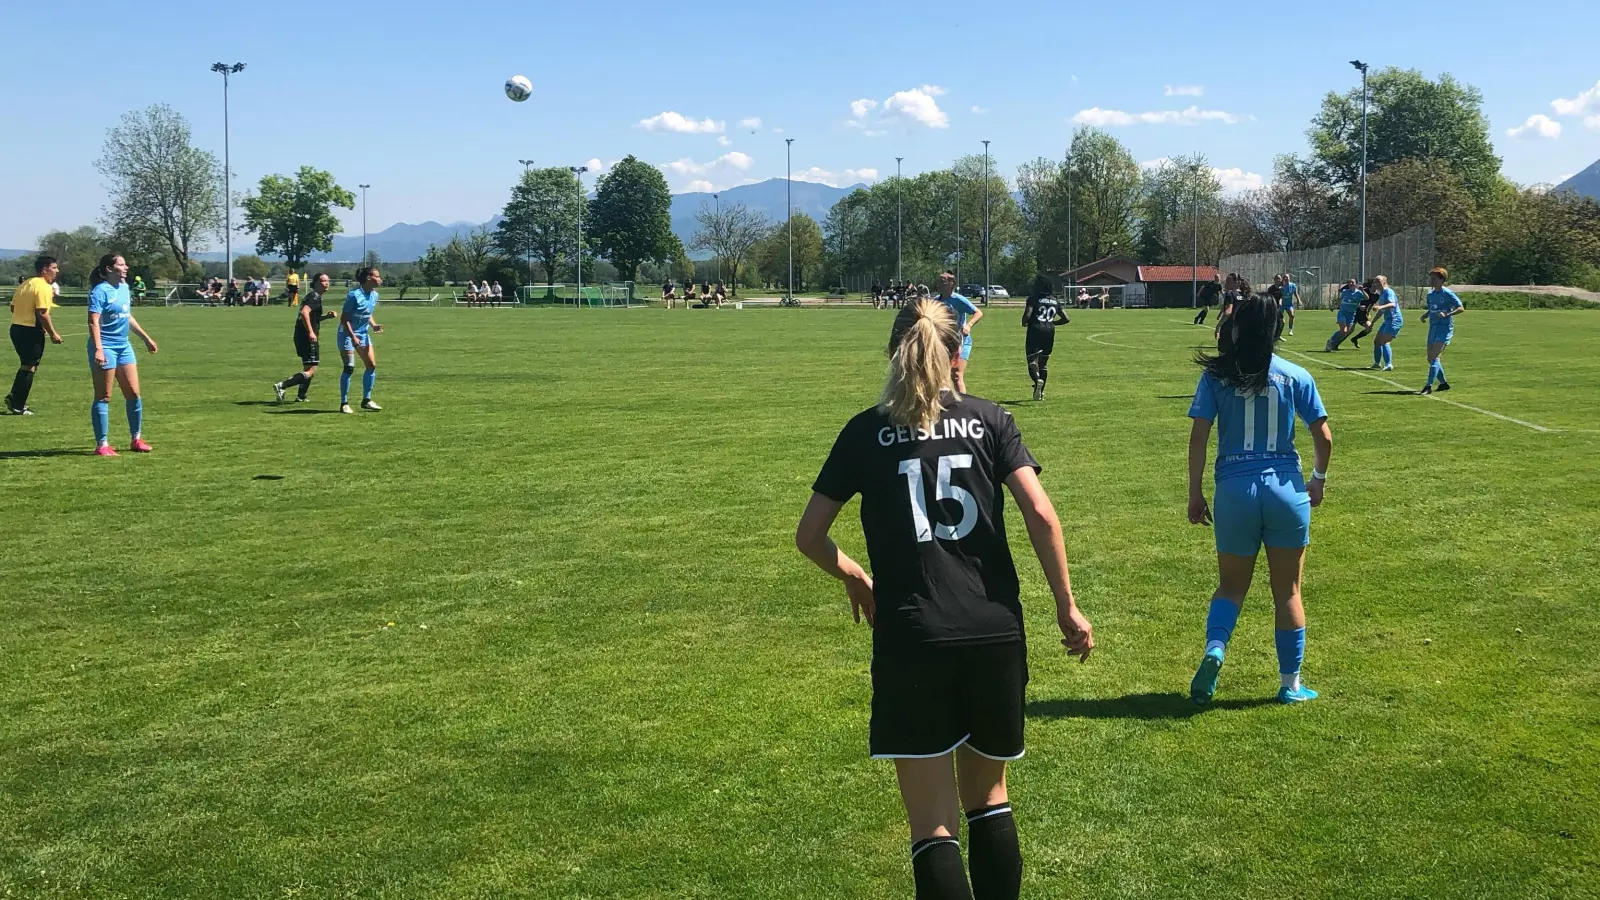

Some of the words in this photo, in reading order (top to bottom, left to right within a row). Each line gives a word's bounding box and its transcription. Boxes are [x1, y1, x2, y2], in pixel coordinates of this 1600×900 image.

[1037, 305, 1056, 322] 20
[877, 417, 985, 447] GEISLING
[1235, 385, 1279, 452] 11
[897, 454, 979, 543] 15
